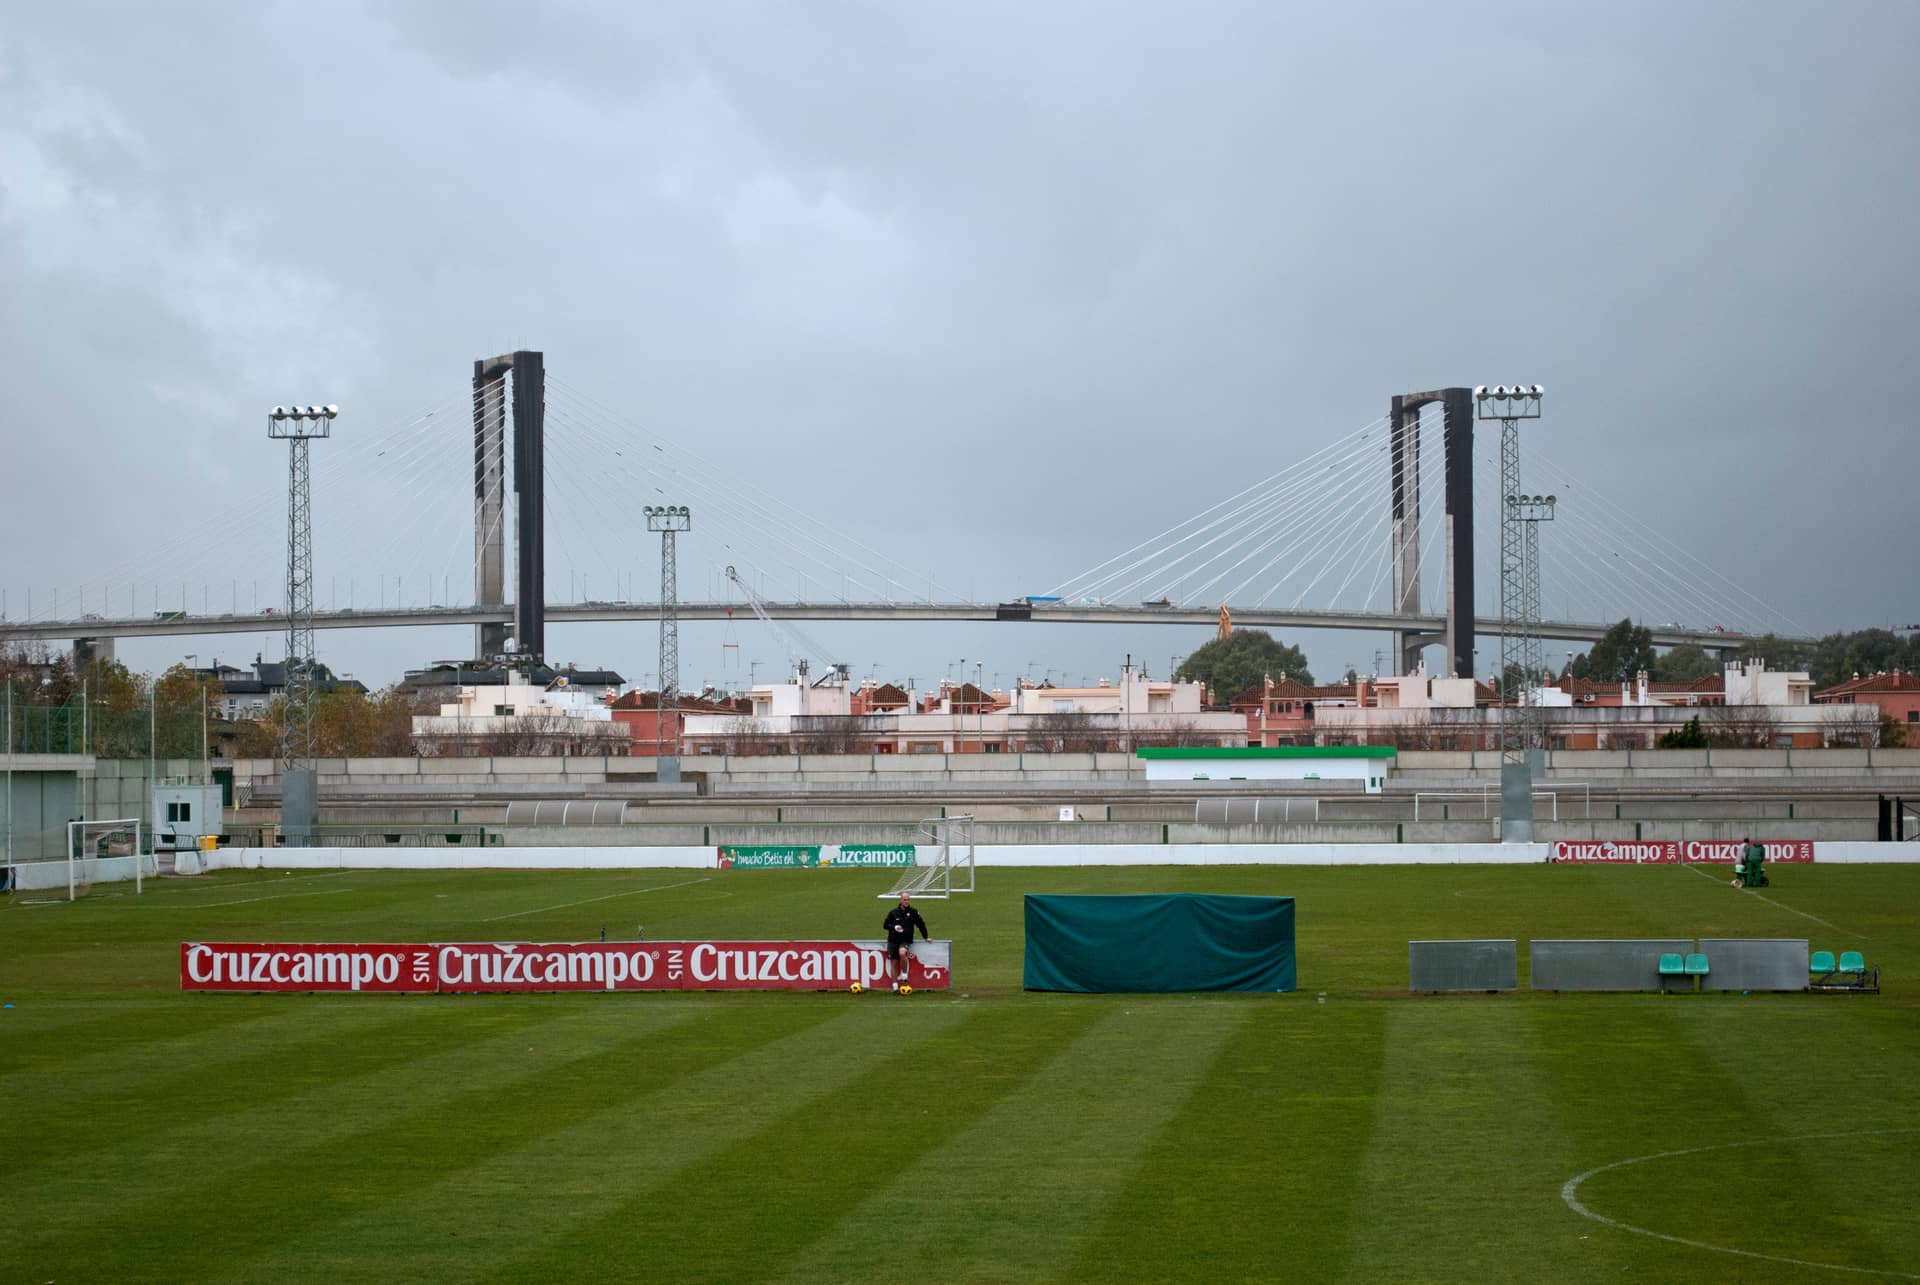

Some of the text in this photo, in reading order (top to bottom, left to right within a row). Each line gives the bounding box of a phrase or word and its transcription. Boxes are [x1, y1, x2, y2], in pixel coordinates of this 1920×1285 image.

[830, 850, 907, 866] uzcampo
[1554, 842, 1676, 863] Cruzcampo SIN
[1687, 841, 1810, 863] Cruzcpo SIN
[187, 945, 430, 990] Cruzcampo SIN
[438, 946, 683, 990] Cruzcampo SIN
